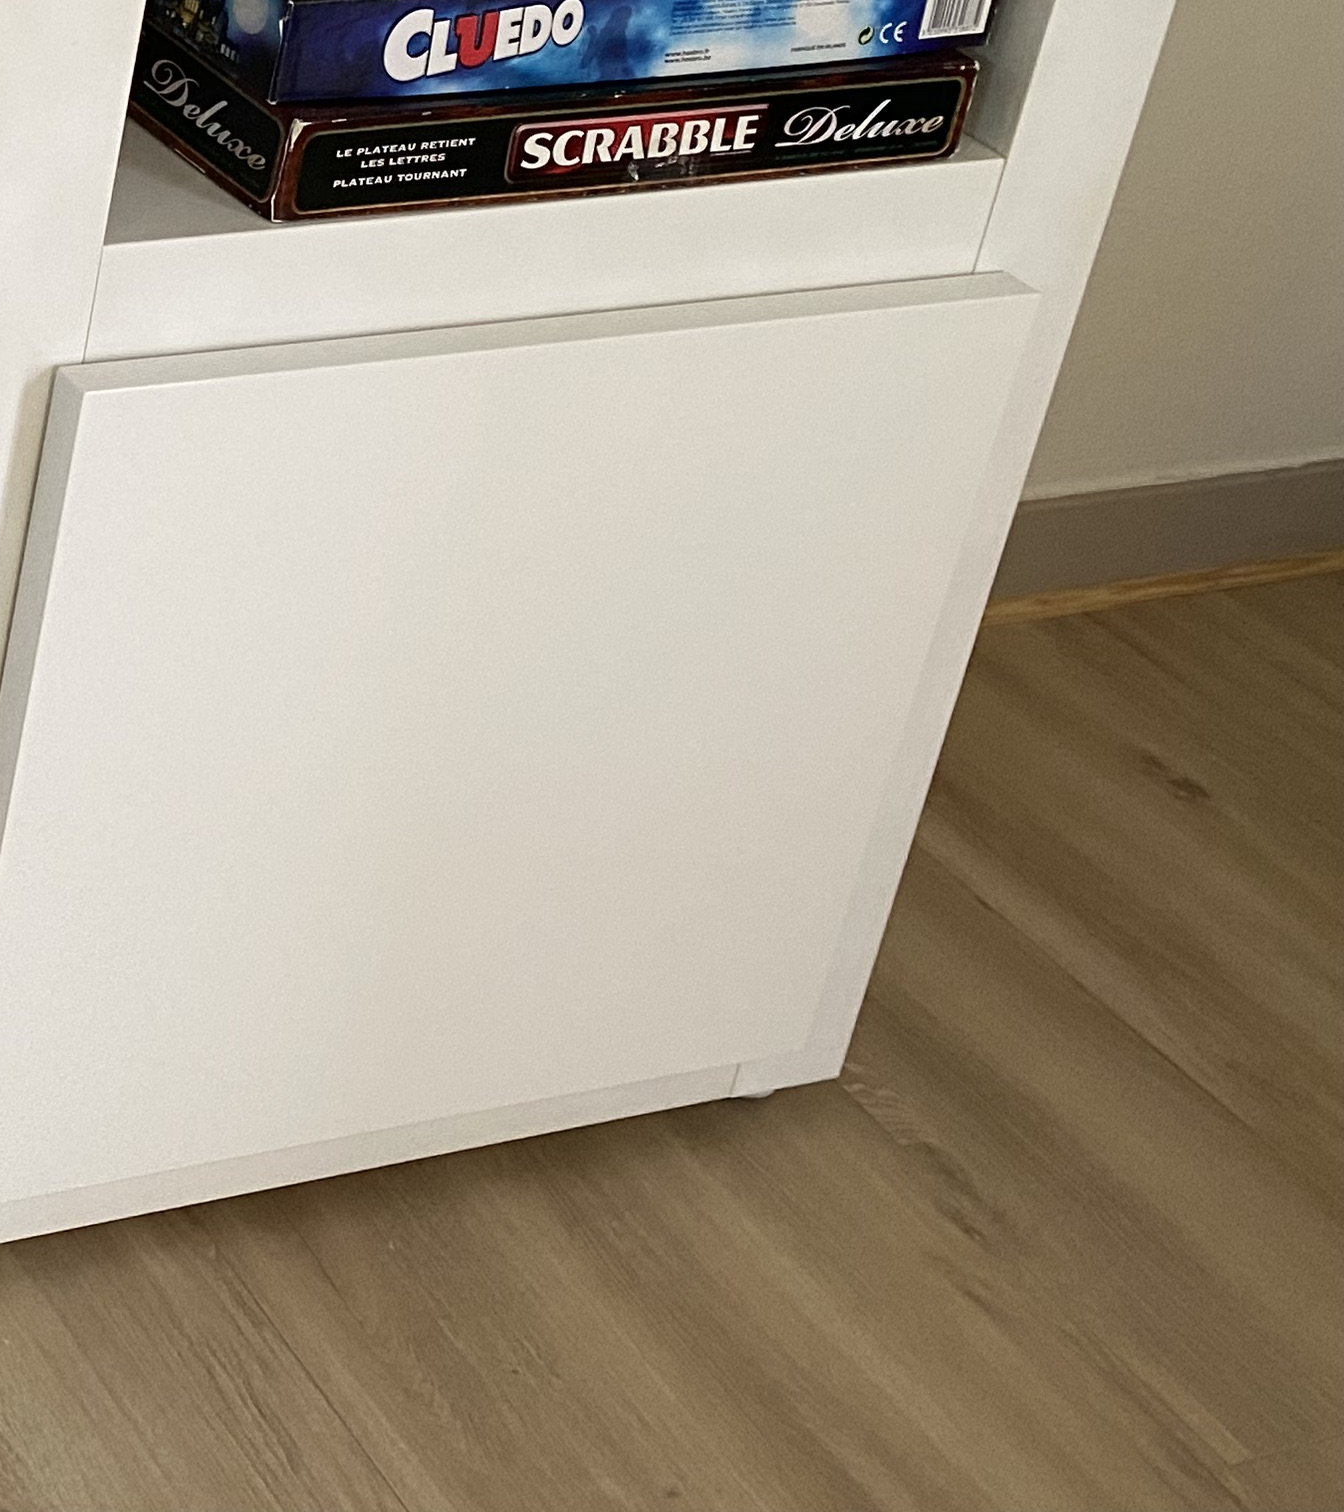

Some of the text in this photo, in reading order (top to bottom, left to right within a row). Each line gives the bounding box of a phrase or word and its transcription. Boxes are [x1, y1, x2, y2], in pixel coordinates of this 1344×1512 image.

[143, 58, 266, 171] Deluxe
[520, 99, 944, 170] SCRABBLE Deluxe
[336, 137, 477, 159] LE PLATEAU RETIENT
[360, 152, 447, 170] LES LETTRES
[332, 168, 468, 189] PLATEAU TOURNANT
